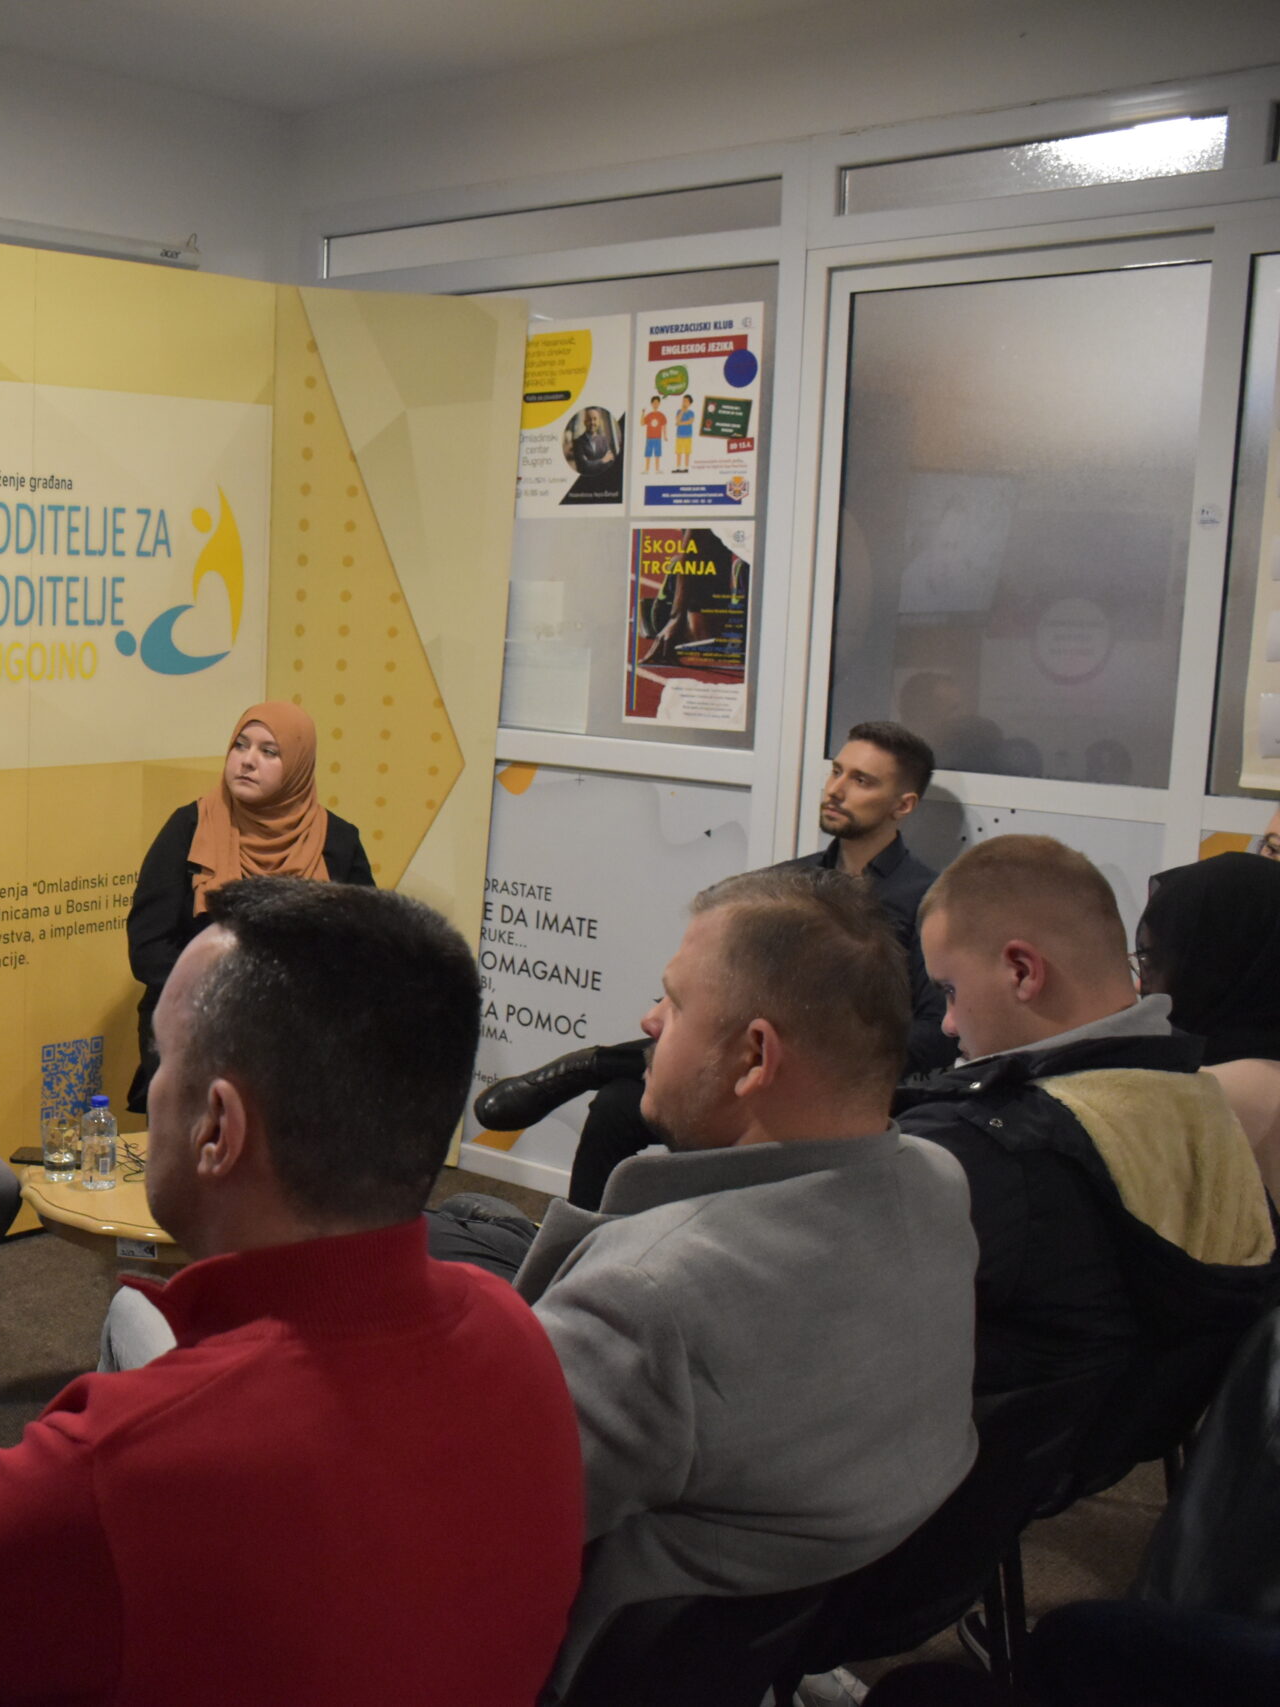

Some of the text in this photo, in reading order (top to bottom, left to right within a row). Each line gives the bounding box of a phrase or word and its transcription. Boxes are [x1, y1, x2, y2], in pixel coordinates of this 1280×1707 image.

[713, 320, 734, 330] KLUB
[661, 341, 734, 356] ENGLESKOG JEZIKA
[29, 475, 73, 492] građana
[135, 508, 172, 558] ZA
[643, 536, 698, 554] ŠKOLA
[642, 556, 717, 575] TRČANJA
[112, 871, 140, 887] cent
[54, 904, 62, 916] u
[66, 896, 102, 915] Bosni
[105, 895, 109, 909] i
[39, 929, 46, 940] a
[50, 915, 128, 940] implementir
[483, 901, 598, 939] E DA IMATE
[479, 950, 602, 992] OMAGANJE
[480, 975, 495, 993] BI,
[506, 1003, 587, 1040] POMOĆ
[480, 1024, 513, 1044] IMA.
